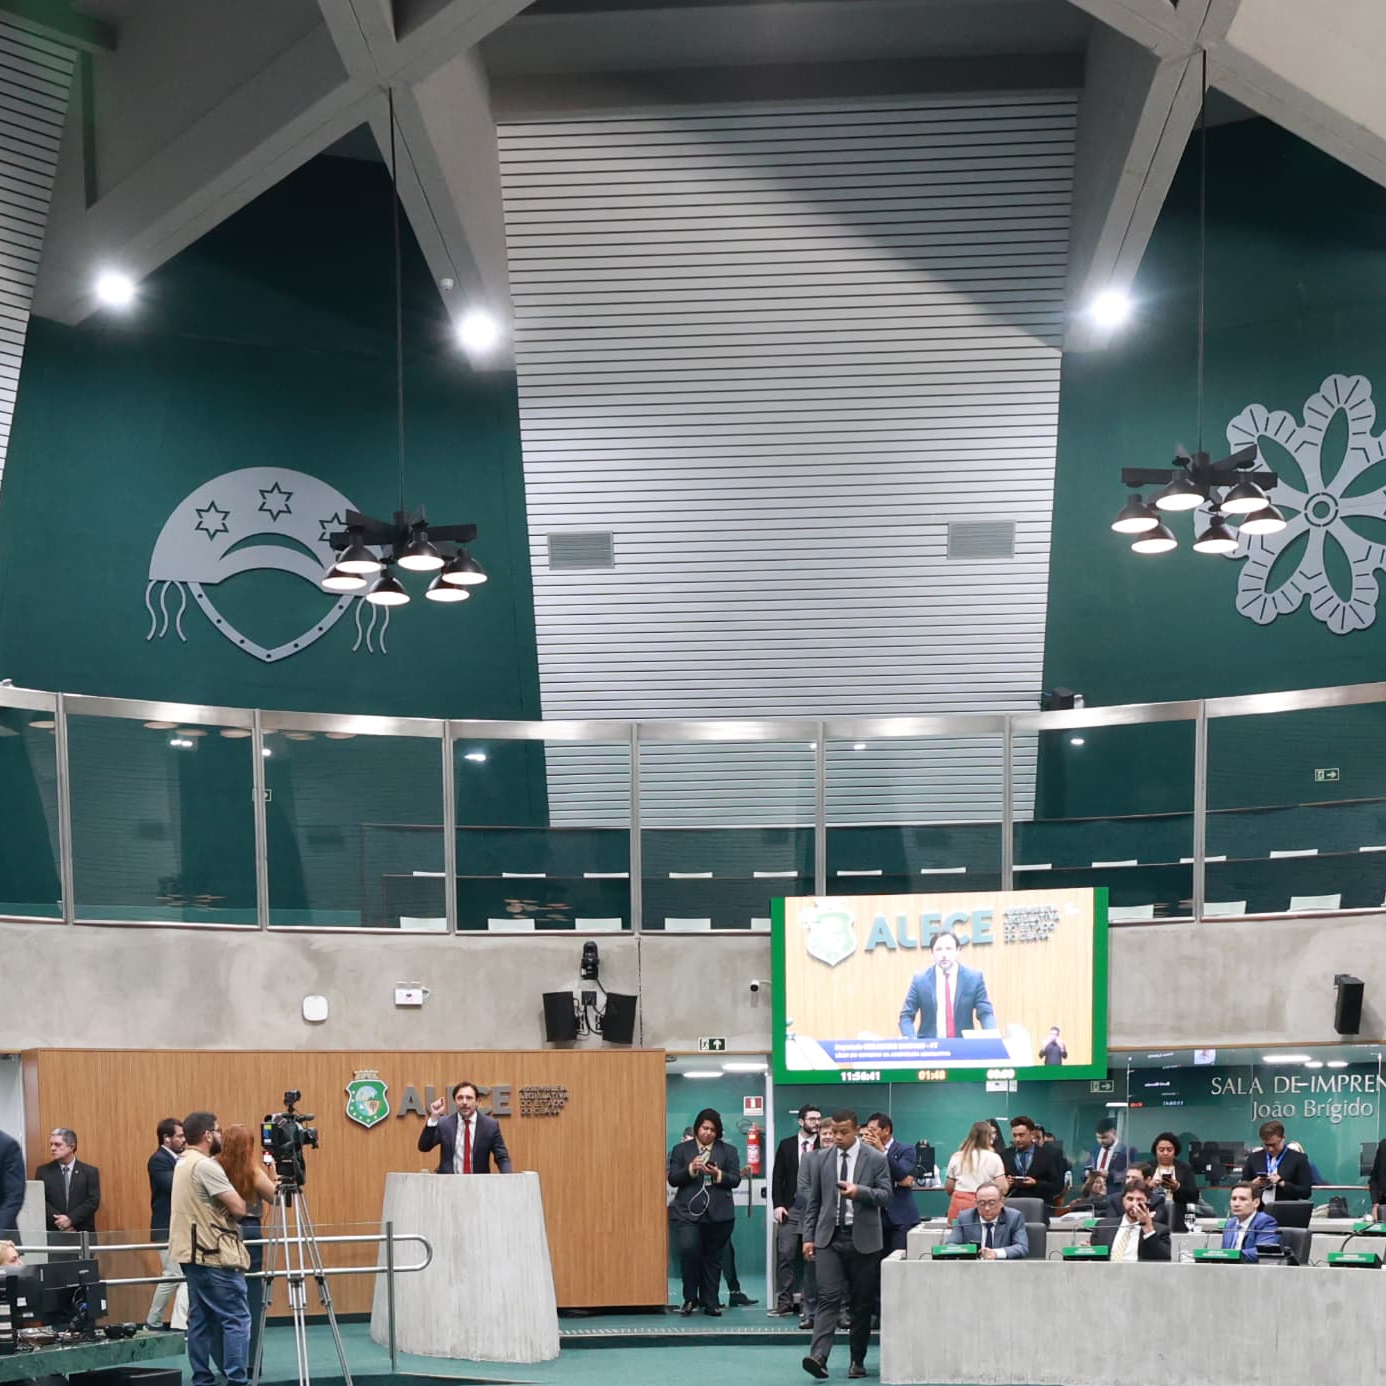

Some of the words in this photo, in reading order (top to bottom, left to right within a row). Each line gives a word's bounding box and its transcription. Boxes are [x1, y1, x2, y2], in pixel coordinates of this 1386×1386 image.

[865, 909, 994, 951] ALECE
[1211, 1077, 1264, 1096] SALA
[1274, 1076, 1302, 1094] DE
[1252, 1100, 1296, 1121] João
[1304, 1096, 1374, 1123] Brígido
